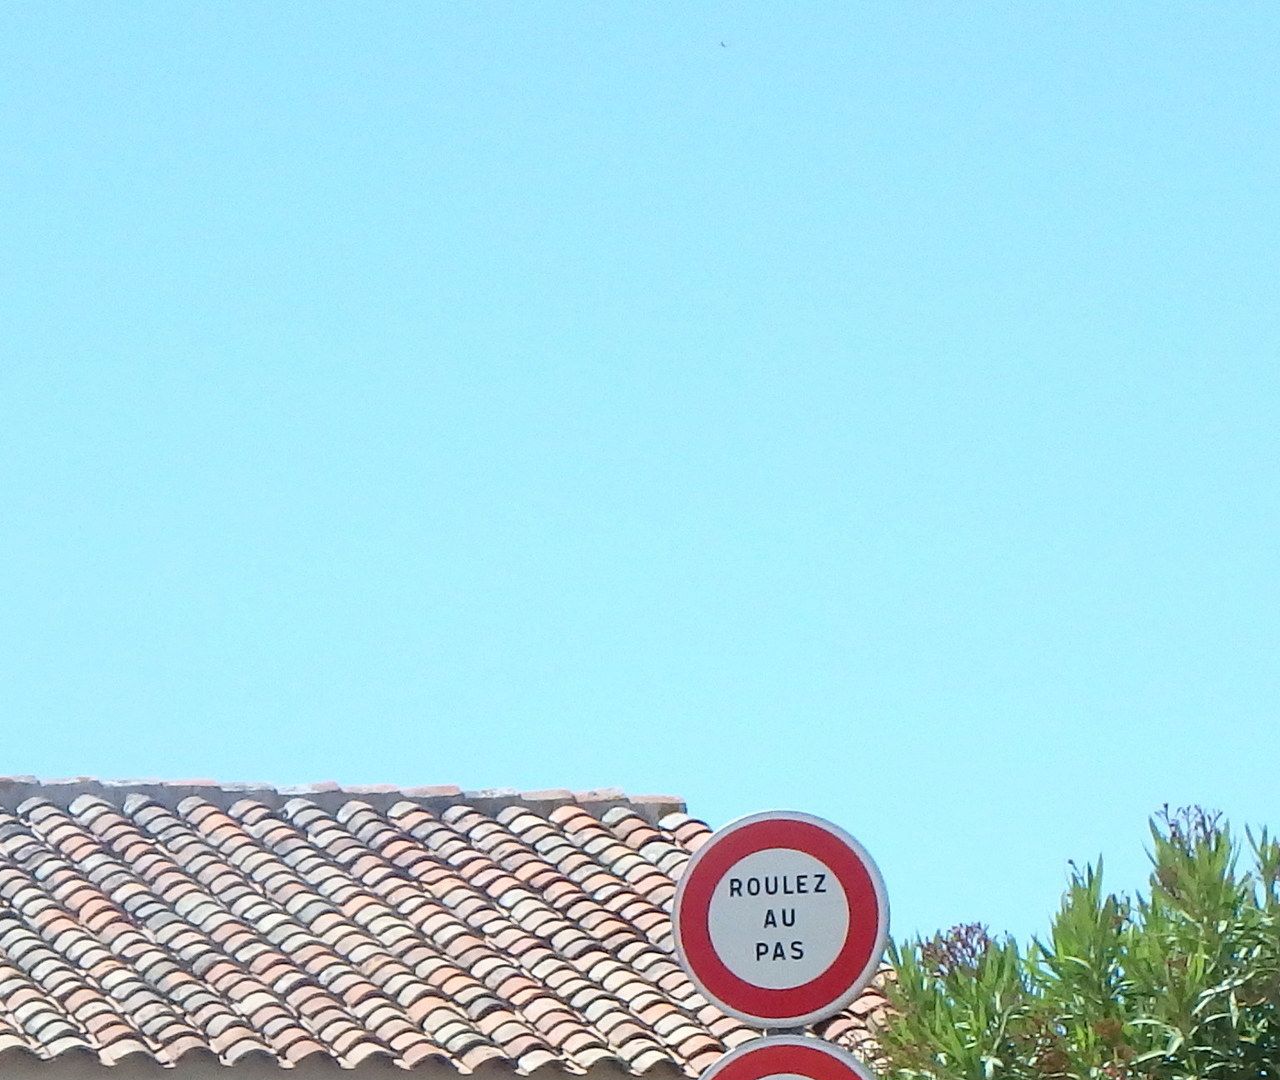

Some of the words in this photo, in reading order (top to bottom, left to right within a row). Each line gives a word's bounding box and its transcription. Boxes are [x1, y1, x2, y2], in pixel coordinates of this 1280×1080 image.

[729, 873, 827, 898] ROULEZ
[763, 909, 796, 928] AU
[755, 941, 804, 962] PAS
